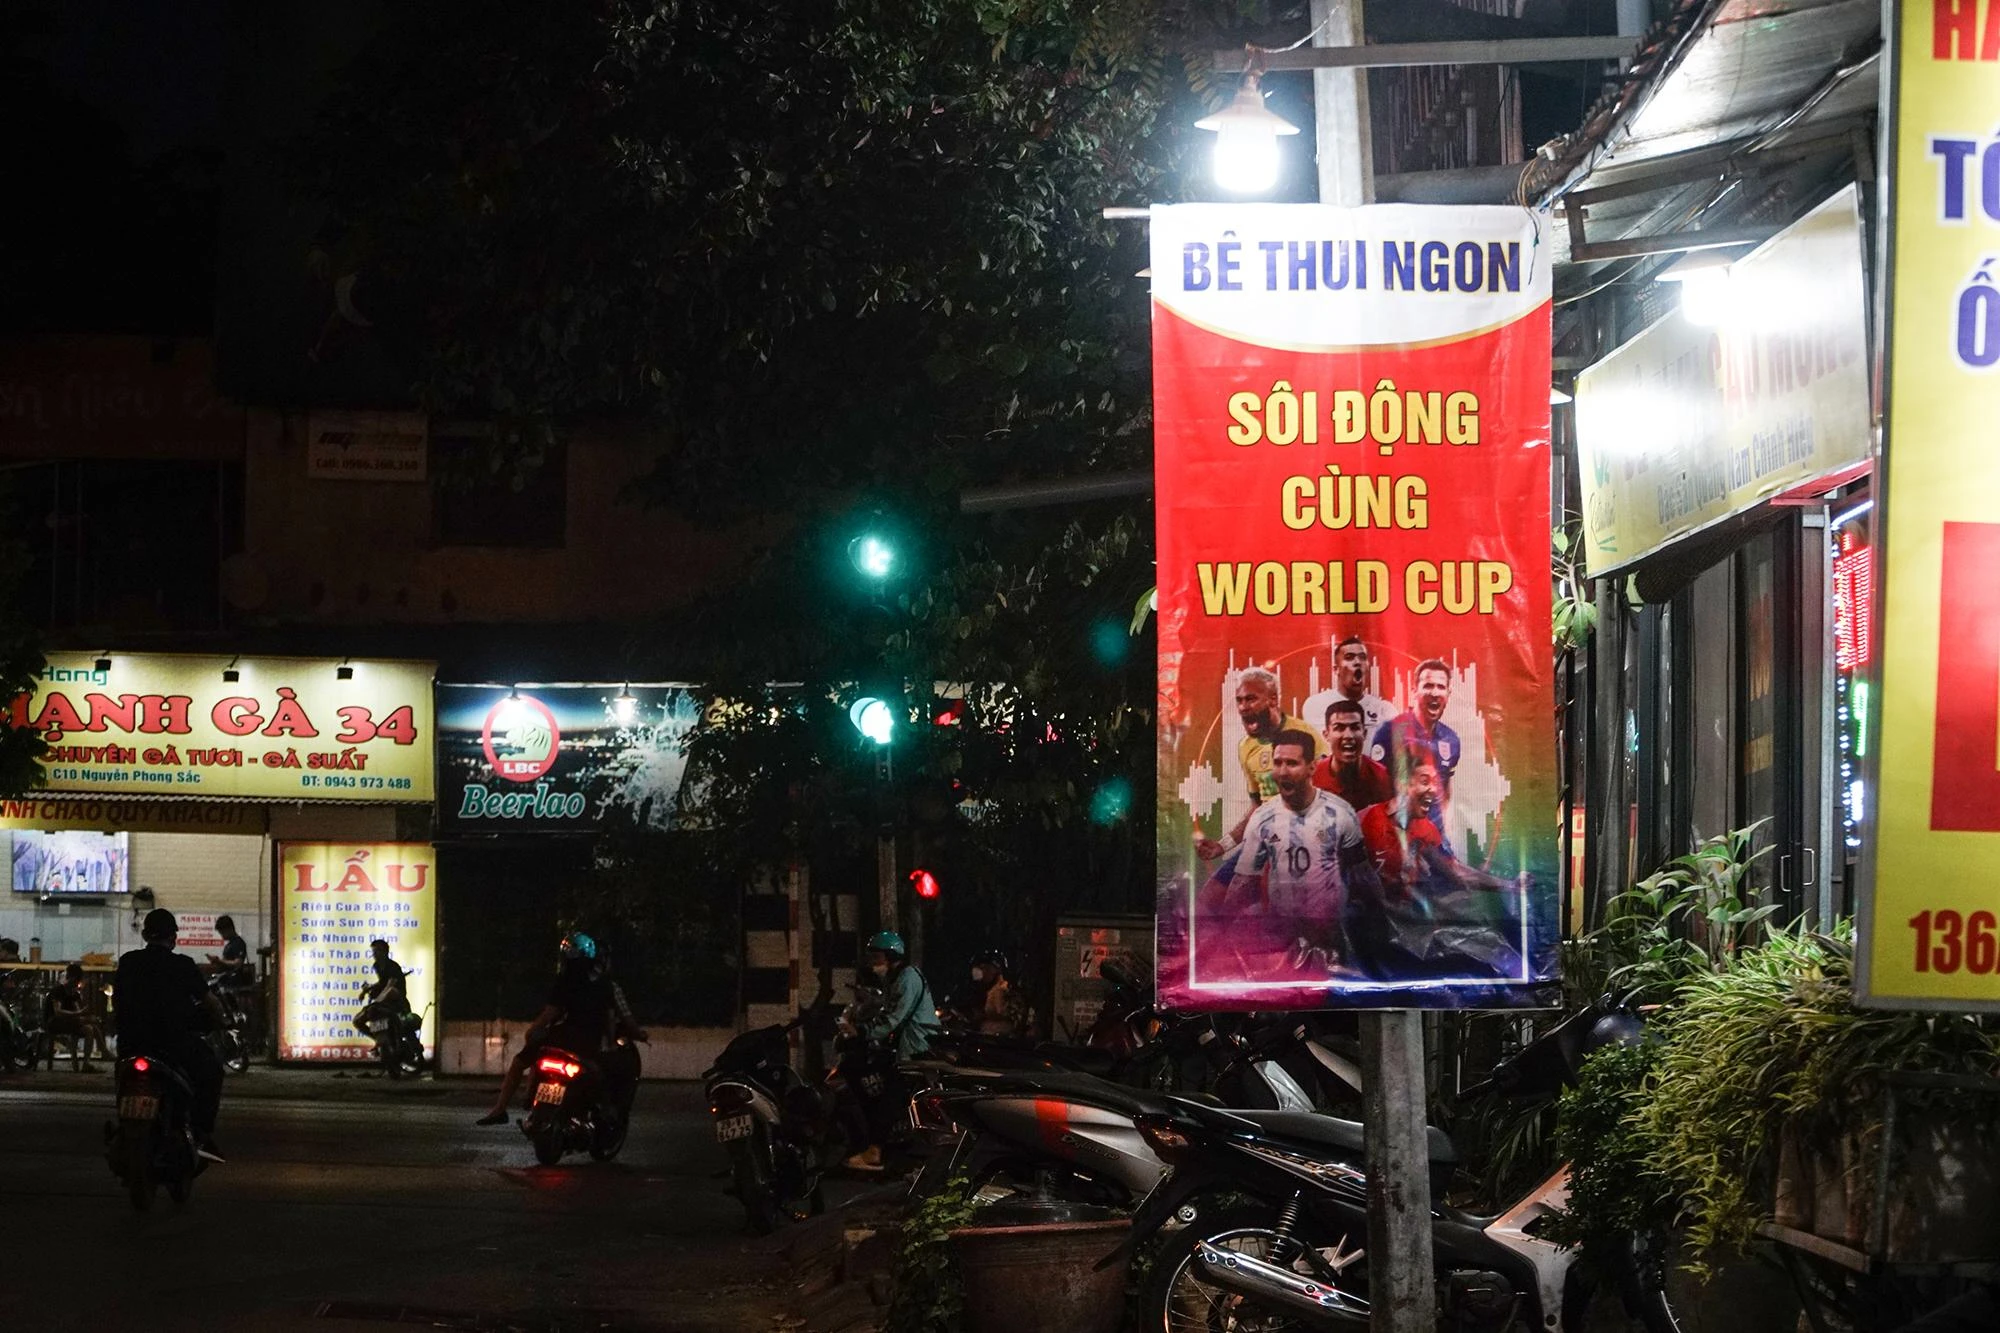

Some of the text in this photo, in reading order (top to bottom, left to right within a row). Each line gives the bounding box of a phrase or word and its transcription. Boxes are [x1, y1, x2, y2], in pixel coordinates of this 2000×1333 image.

[1182, 230, 1520, 293] BÊ THUI NGON
[1227, 378, 1480, 456] SÔI ĐỘNG
[1281, 464, 1429, 530] CÙNG
[1196, 560, 1512, 616] WORLD CUP
[211, 687, 320, 738] GÀ
[335, 705, 418, 746] 34
[53, 768, 77, 780] C10
[133, 770, 172, 783] Phong
[142, 744, 182, 766] GÀ
[186, 748, 243, 767] TƯƠI
[262, 748, 302, 768] GÀ
[307, 747, 369, 770] SUẤT
[503, 762, 541, 774] LBC
[325, 776, 356, 788] 0943
[360, 777, 384, 789] 973
[388, 777, 411, 790] 488
[458, 783, 586, 818] Beerlao
[294, 850, 429, 892] LẨU
[1286, 846, 1311, 877] 10
[336, 902, 360, 911] Cua
[1908, 909, 2000, 975] 136
